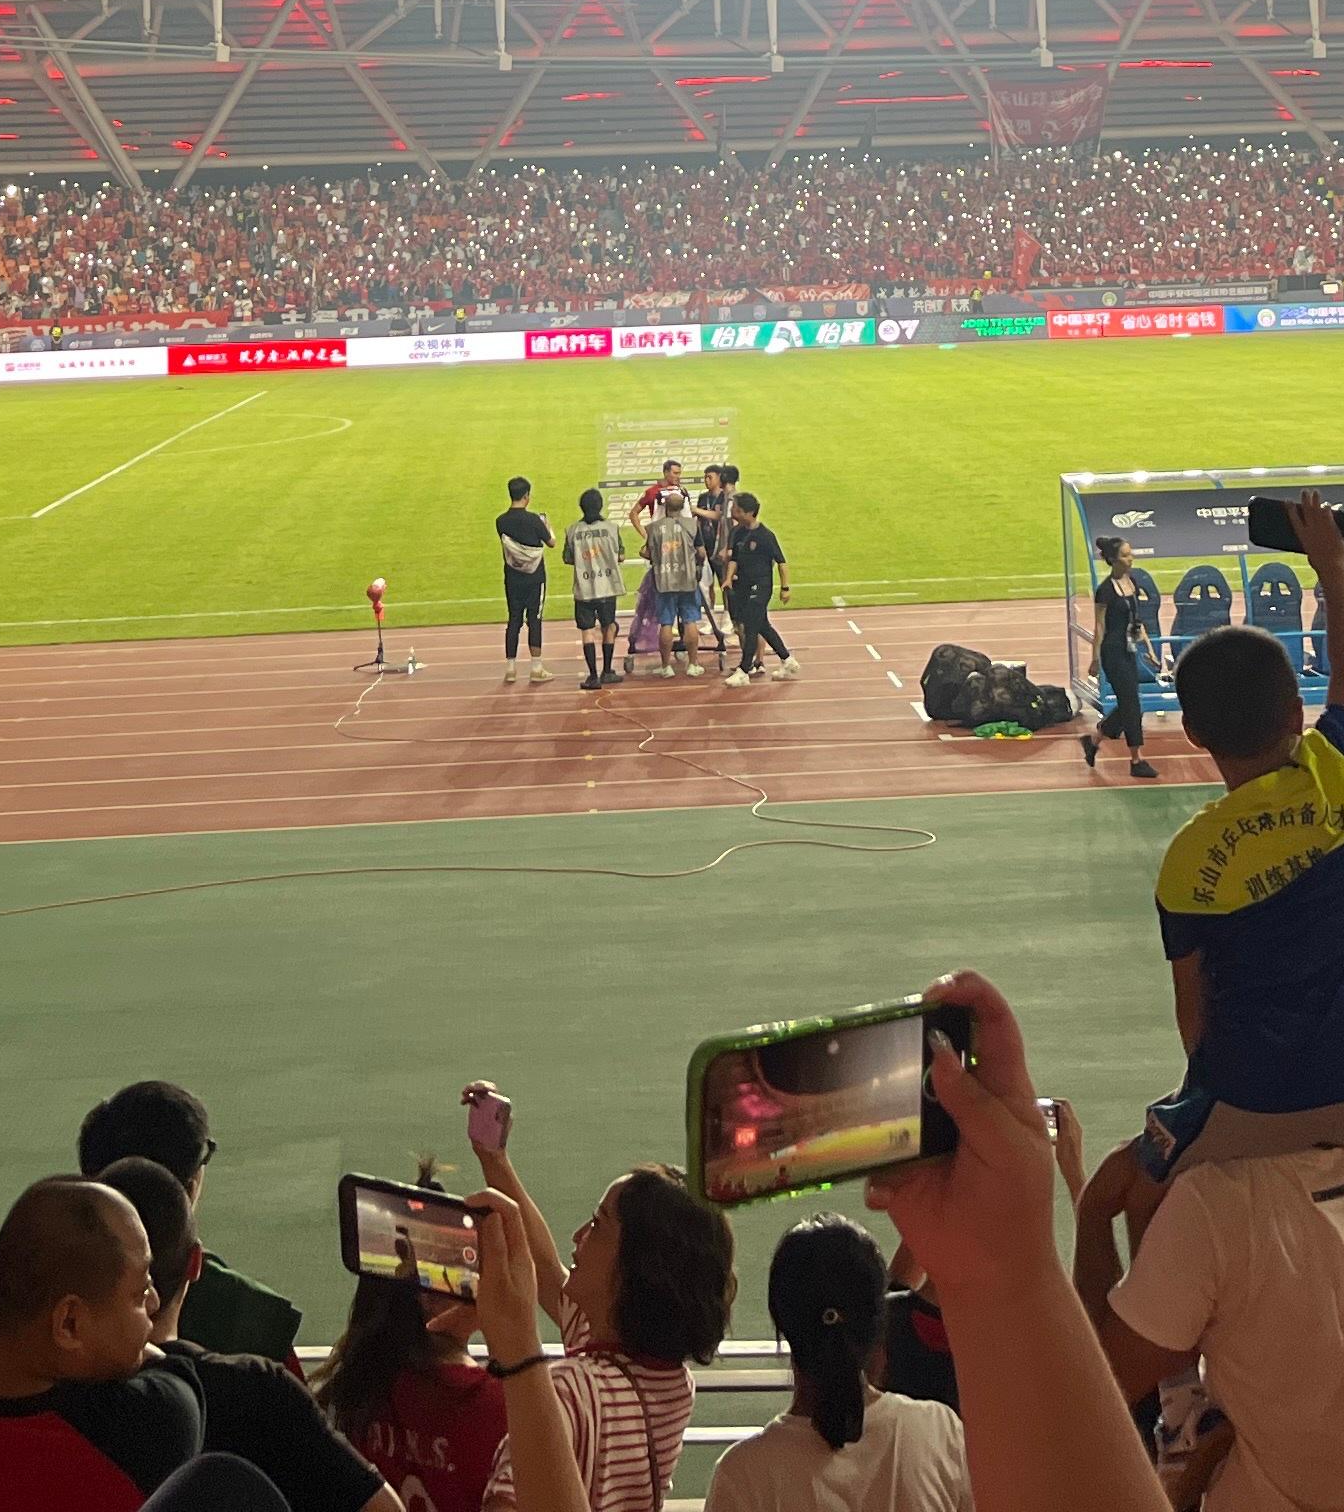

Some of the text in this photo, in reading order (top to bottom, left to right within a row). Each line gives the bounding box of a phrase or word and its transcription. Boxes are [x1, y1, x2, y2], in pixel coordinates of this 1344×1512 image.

[961, 317, 1046, 329] JOIN THE CLUB
[1052, 314, 1111, 326] 中国平安
[1121, 311, 1216, 330] 省心 省时 省钱
[414, 338, 466, 351] 央视体育
[531, 335, 606, 353] 途虎养车
[621, 331, 693, 349] 途虎养车
[408, 352, 431, 360] CCTV
[1136, 520, 1156, 528] CSL
